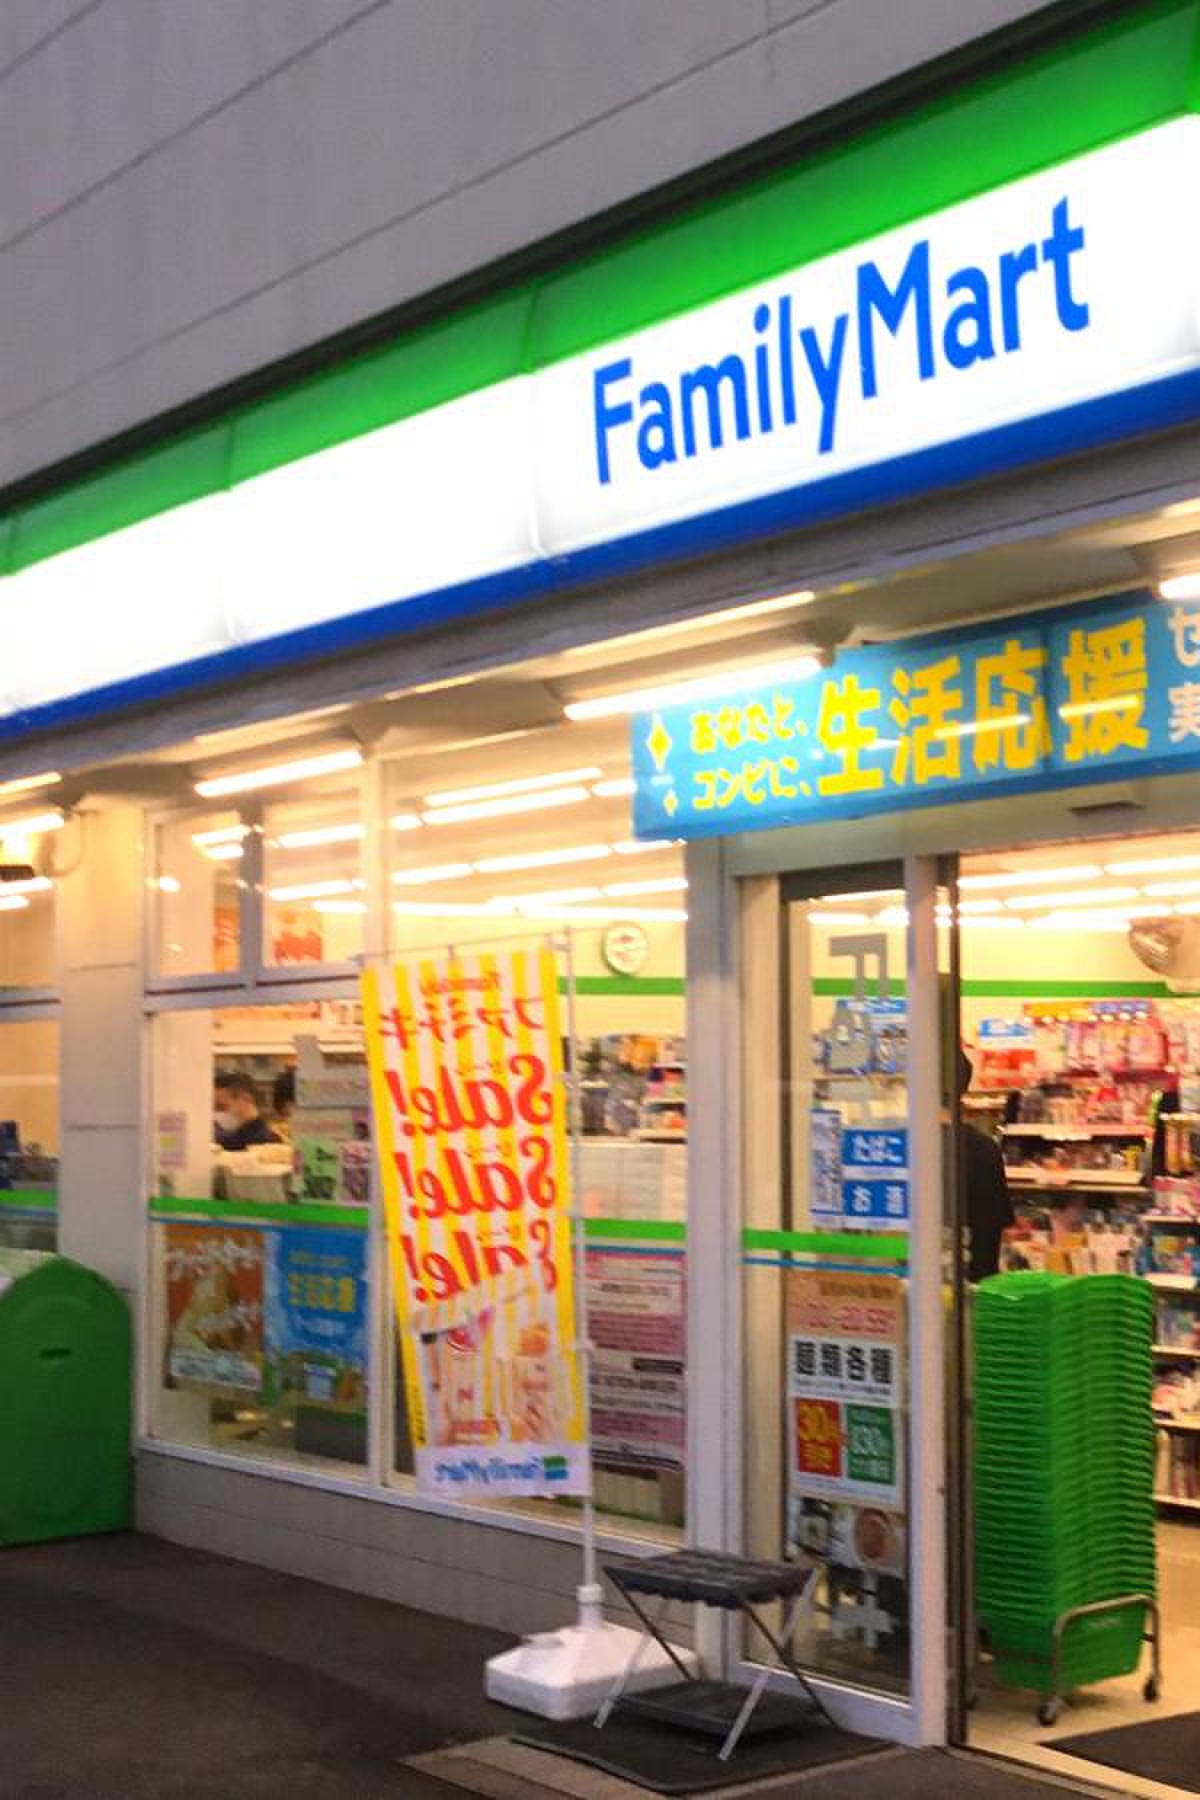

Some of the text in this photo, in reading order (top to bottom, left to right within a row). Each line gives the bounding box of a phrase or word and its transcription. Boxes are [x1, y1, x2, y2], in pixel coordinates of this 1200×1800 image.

[593, 196, 1090, 485] FamilyMart
[818, 617, 1149, 797] 生活応援
